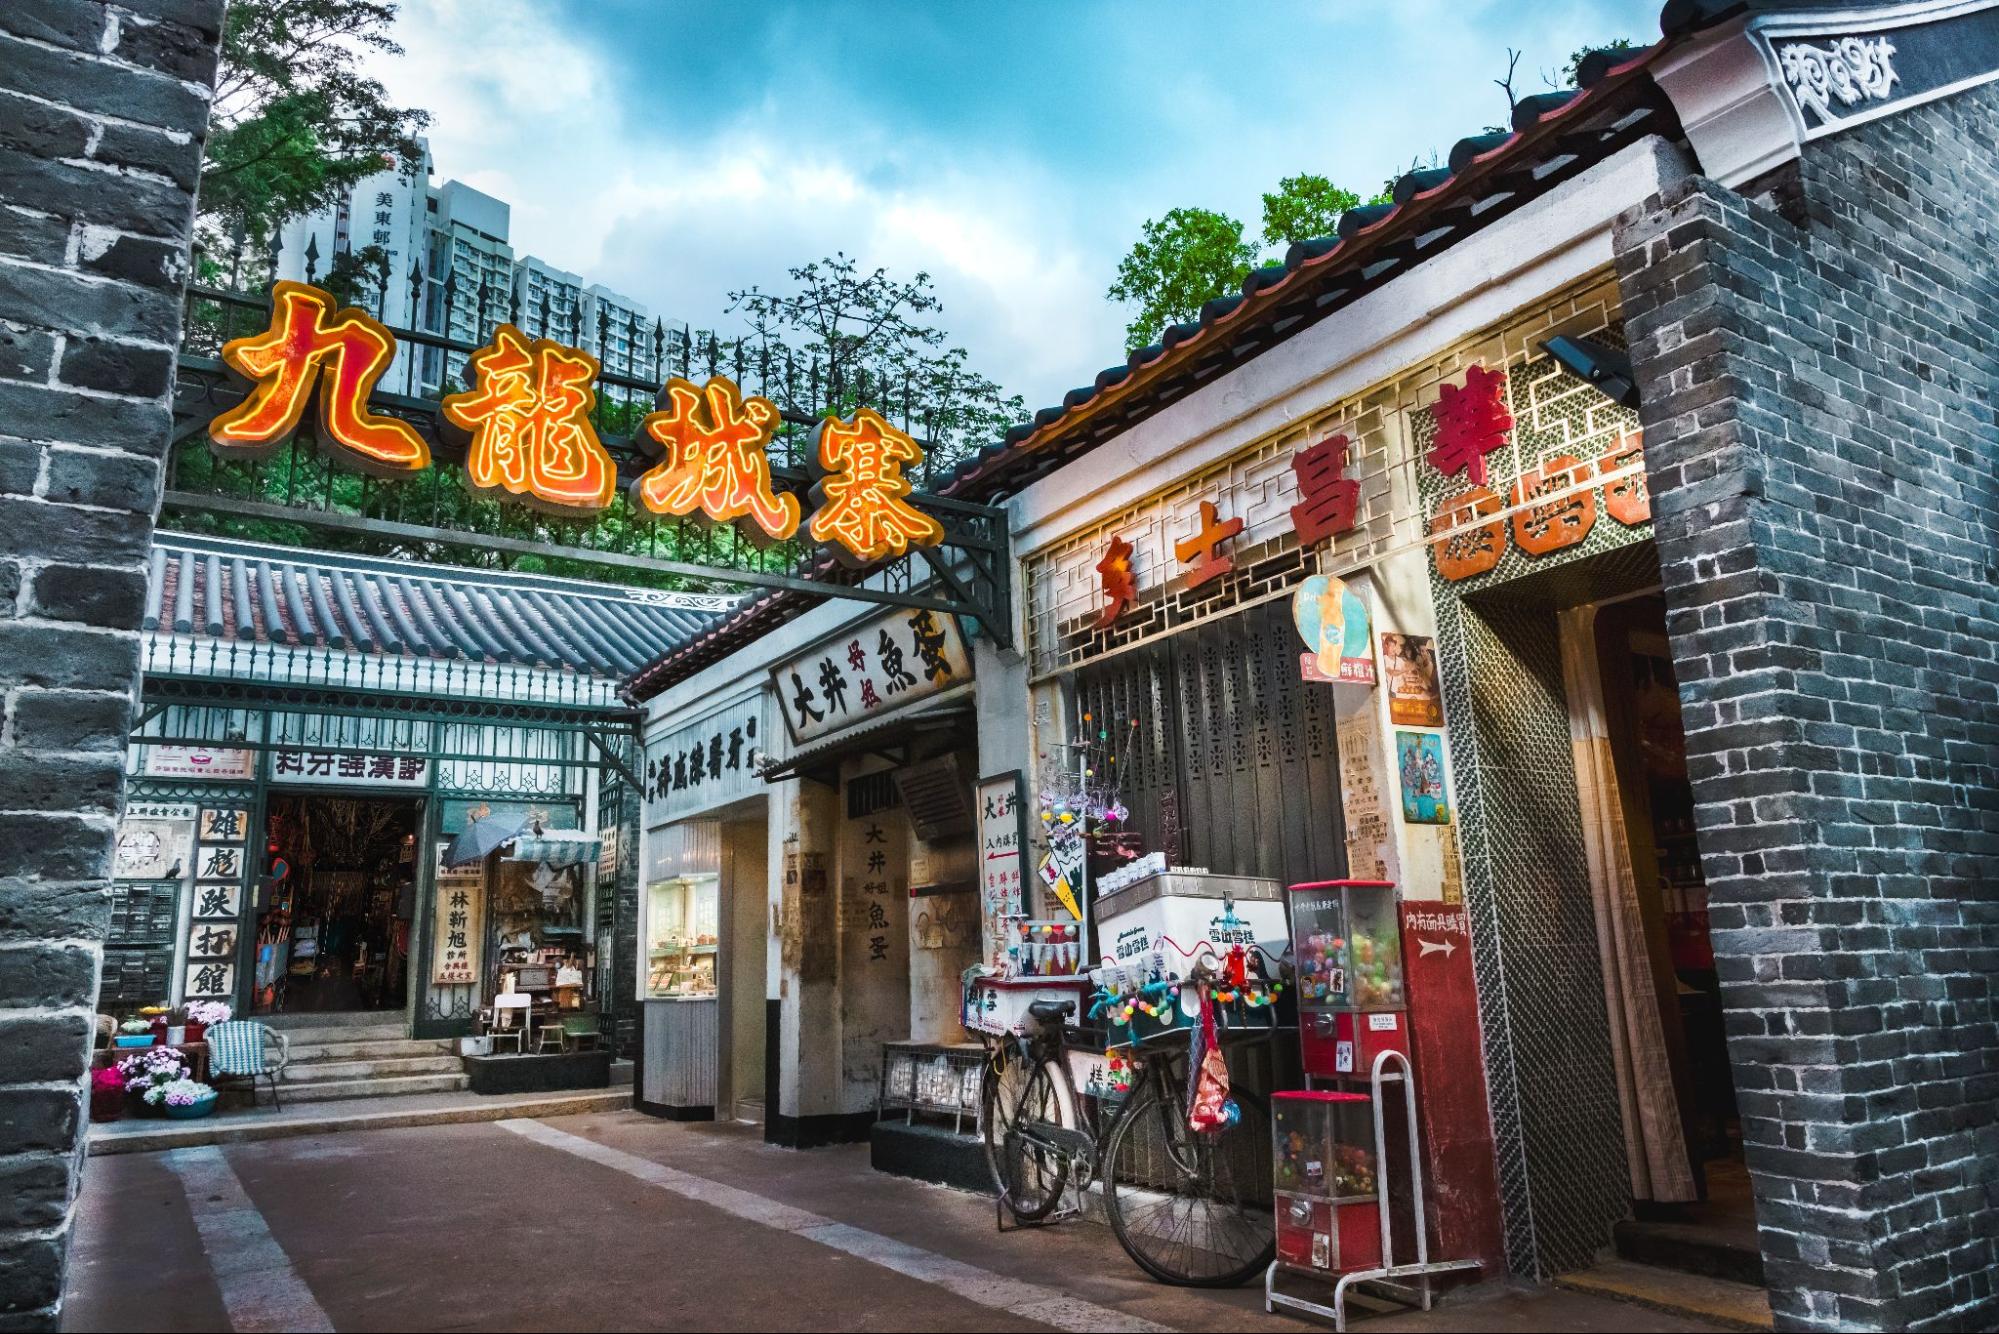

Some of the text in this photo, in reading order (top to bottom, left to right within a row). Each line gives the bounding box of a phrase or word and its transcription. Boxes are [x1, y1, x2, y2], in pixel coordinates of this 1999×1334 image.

[373, 192, 392, 245] 美東邨
[210, 281, 944, 567] 九龍城寨
[193, 810, 242, 995] 雄彪跌打館
[1116, 935, 1149, 960] 雪山雪糕
[1209, 928, 1256, 944] 雪山雪糕
